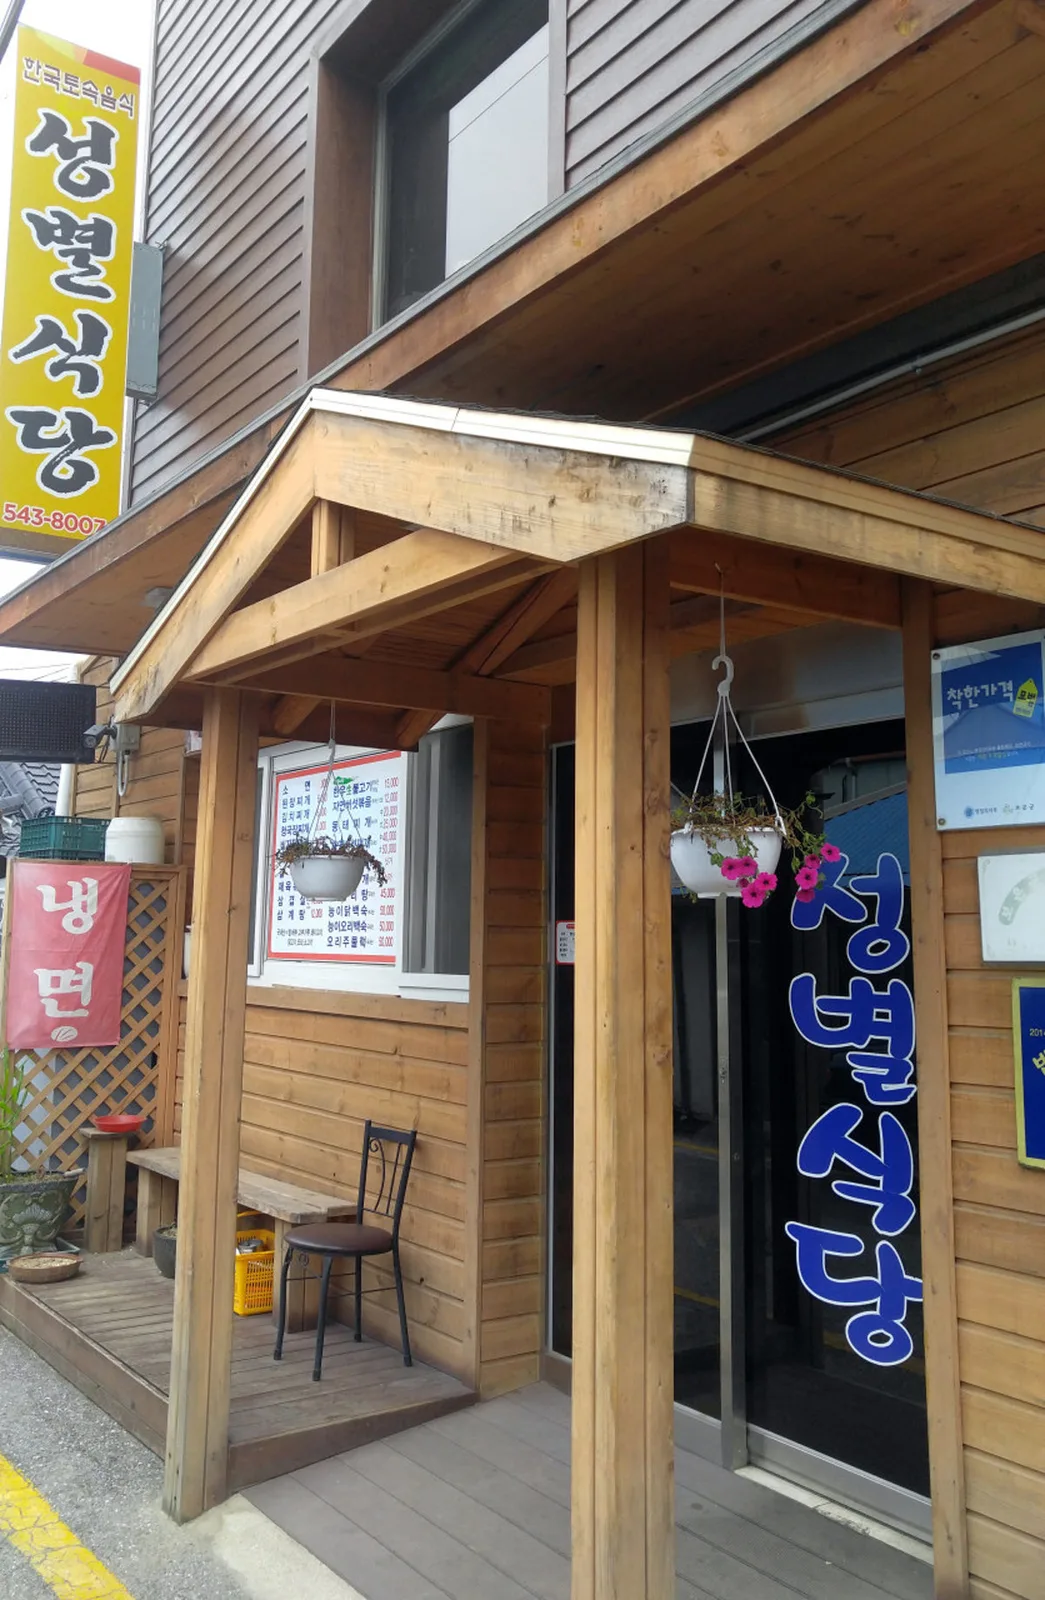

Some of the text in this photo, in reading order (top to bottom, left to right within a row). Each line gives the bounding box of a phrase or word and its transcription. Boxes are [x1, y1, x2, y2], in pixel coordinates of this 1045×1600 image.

[24, 57, 134, 117] 한국토속음식
[4, 502, 107, 534] 543-8007
[947, 680, 1013, 710] 착한가격
[33, 877, 99, 1018] 냉면
